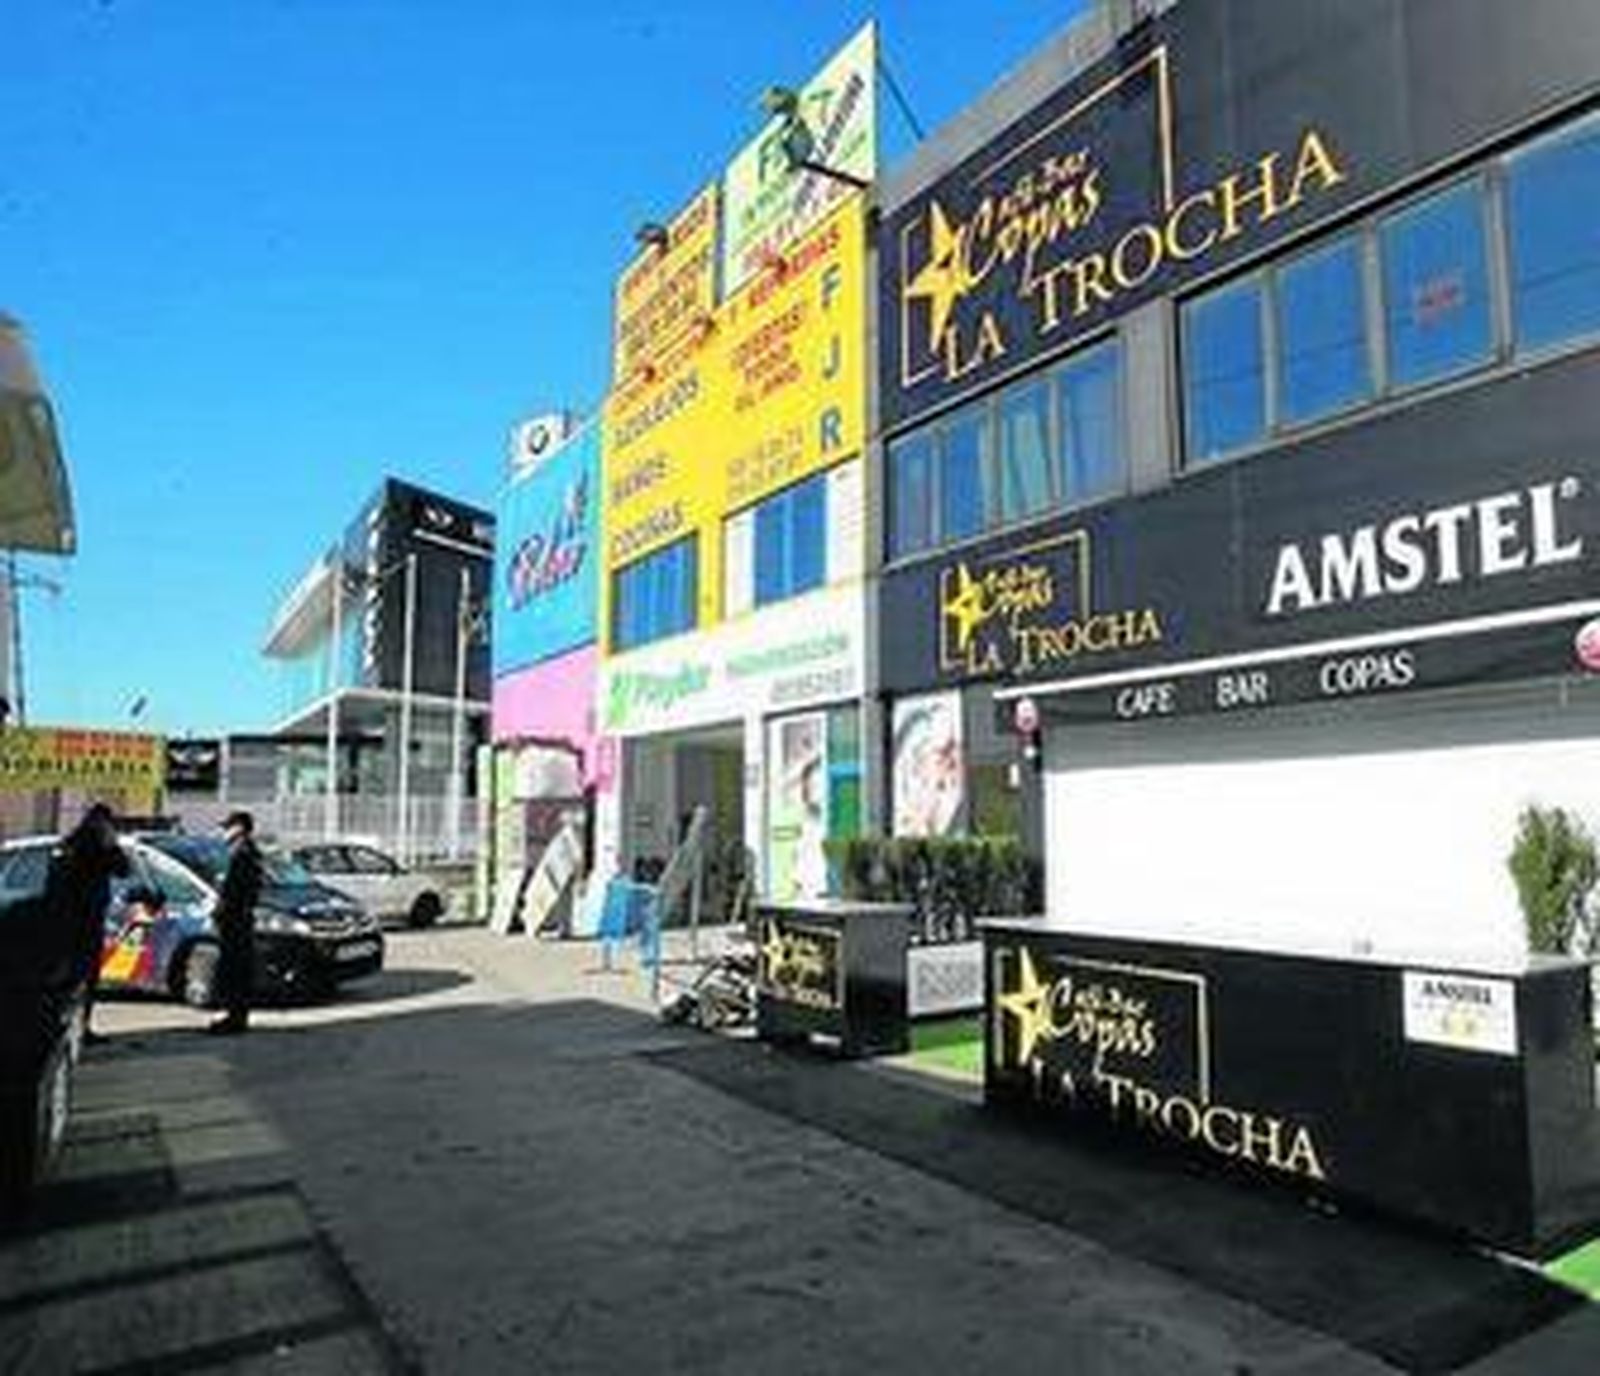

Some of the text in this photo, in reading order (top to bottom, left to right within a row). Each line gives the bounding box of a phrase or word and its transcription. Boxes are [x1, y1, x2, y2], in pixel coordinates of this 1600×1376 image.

[943, 311, 1007, 382] LA
[1030, 130, 1347, 334] TROCHA
[820, 262, 842, 454] F J R
[1265, 480, 1582, 615] AMSTEL
[967, 608, 1163, 676] LA TROCHA
[1216, 672, 1269, 706] BAR
[1320, 652, 1415, 694] COPAS
[1098, 1072, 1326, 1180] TROCHA
